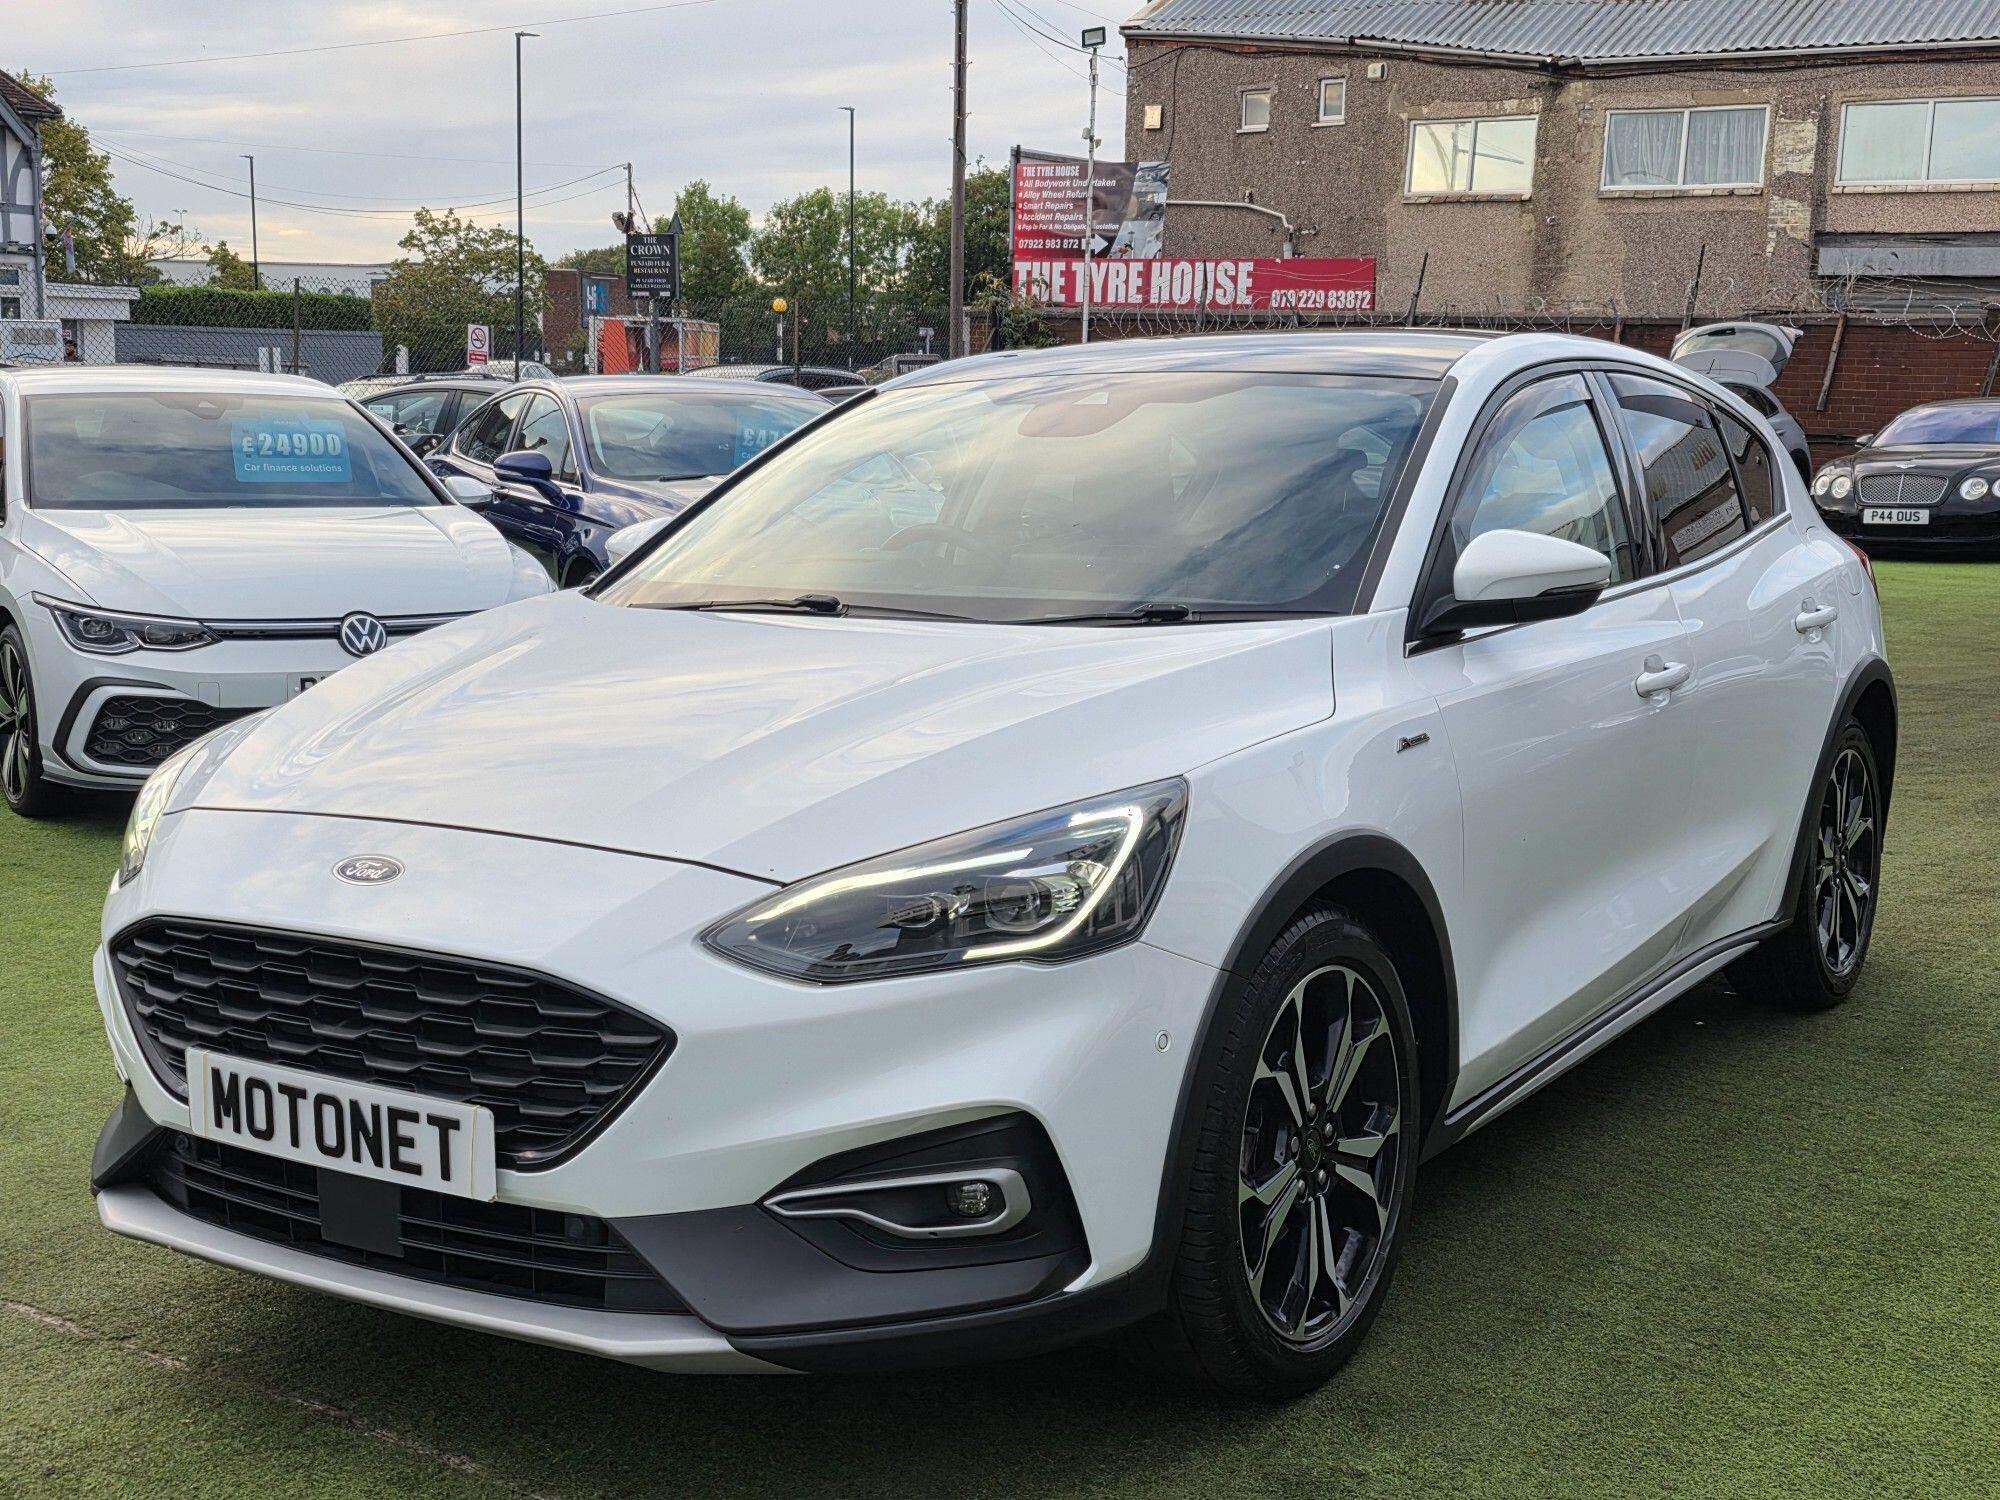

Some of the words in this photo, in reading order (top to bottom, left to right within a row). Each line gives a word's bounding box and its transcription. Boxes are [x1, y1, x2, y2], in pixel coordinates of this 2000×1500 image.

[1023, 166, 1035, 177] THE
[1037, 166, 1055, 177] TYRE
[1056, 165, 1080, 176] HOUSE
[1023, 179, 1034, 188] All
[1034, 179, 1071, 189] Bodywork
[1072, 179, 1117, 188] Undrtaken
[1022, 190, 1040, 200] Alloy
[1042, 190, 1065, 199] Wheel
[1023, 201, 1044, 210] Smart
[1046, 201, 1074, 211] Repairs
[1022, 213, 1053, 221] Accident
[1055, 213, 1083, 222] Repairs
[643, 236, 657, 244] THE
[1018, 239, 1043, 248] 07922
[1046, 239, 1062, 248] 983
[1063, 239, 1079, 248] 872
[630, 244, 670, 255] CROWN
[1014, 261, 1066, 303] THE
[1072, 261, 1144, 304] TYRE
[1151, 260, 1254, 305] HOUSE
[1271, 289, 1296, 308] 079
[1298, 289, 1325, 309] 229
[1327, 289, 1371, 309] 83872
[244, 463, 260, 471] Car
[263, 463, 298, 472] finance
[300, 463, 342, 472] solutions
[1871, 510, 1893, 522] P44
[1896, 511, 1921, 522] OUS
[210, 1065, 461, 1183] MOTONET
